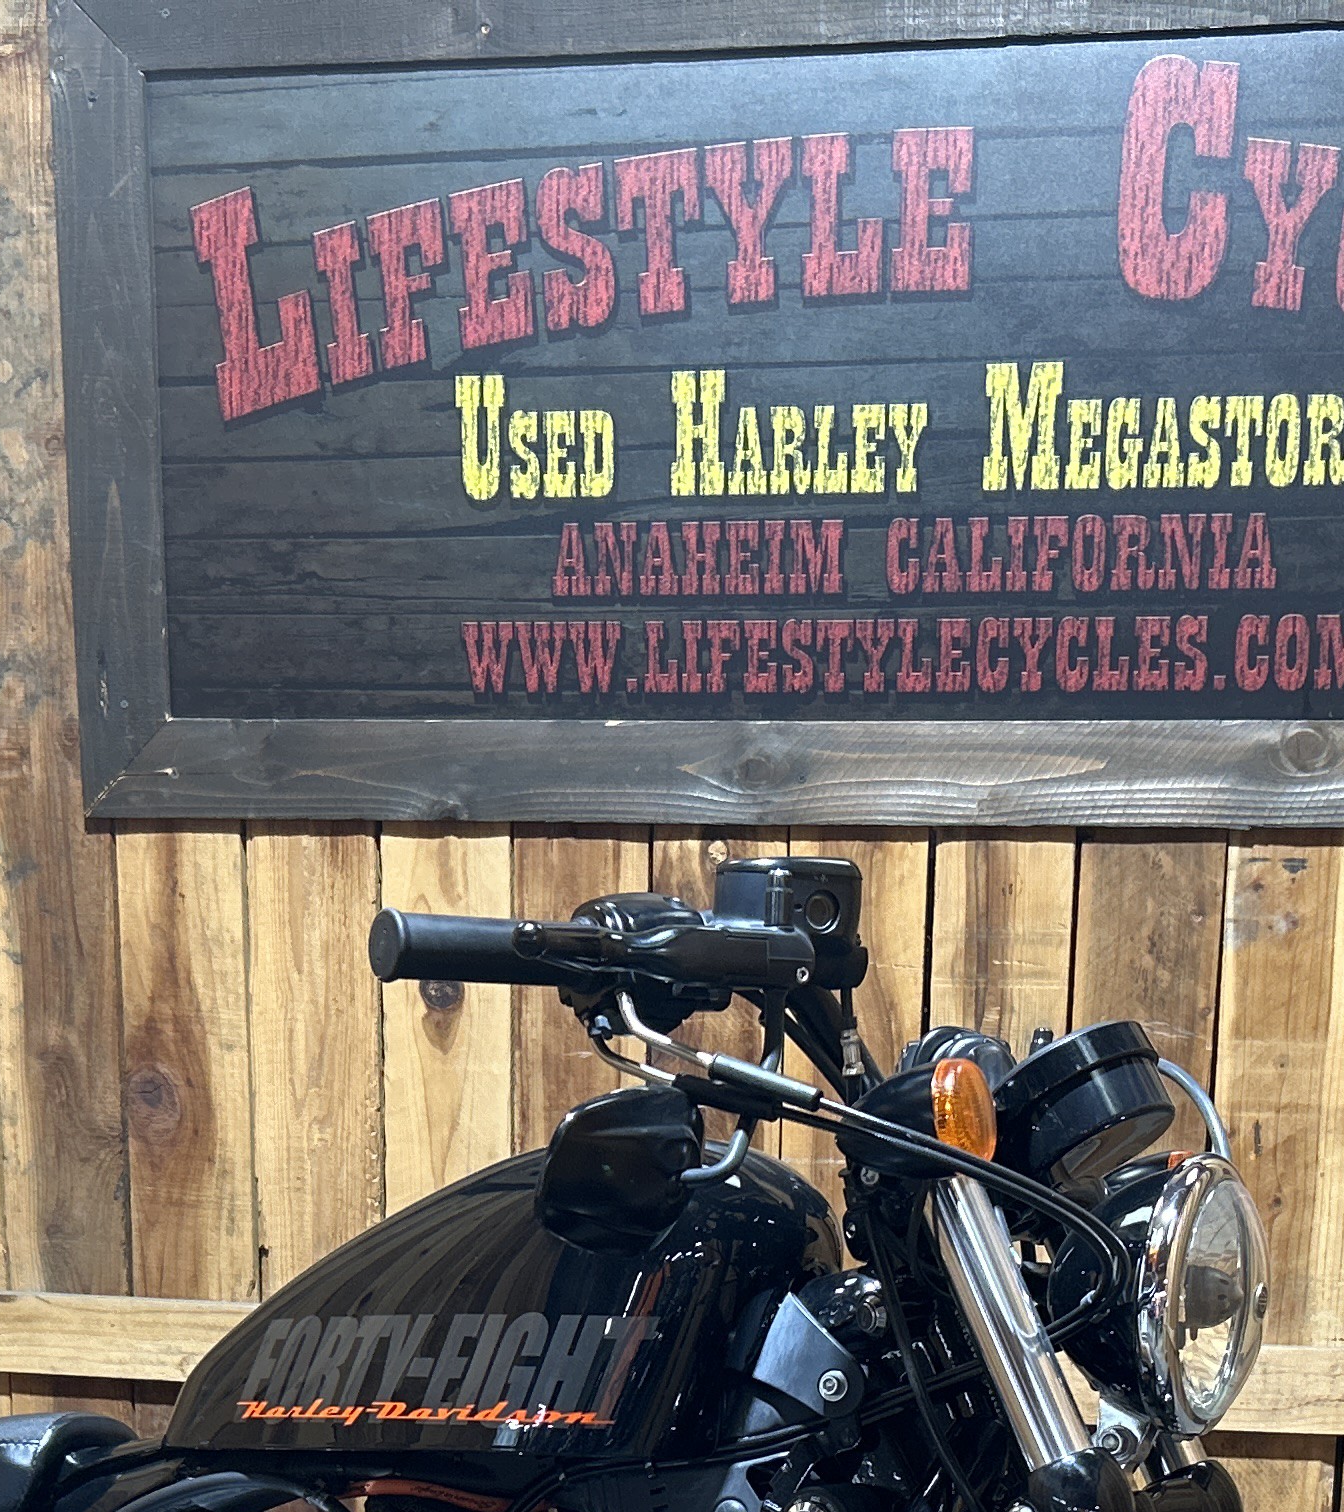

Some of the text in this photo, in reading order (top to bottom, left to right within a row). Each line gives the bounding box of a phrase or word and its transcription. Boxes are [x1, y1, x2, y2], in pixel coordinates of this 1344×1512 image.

[191, 124, 974, 422] LIFESTYLE
[455, 375, 614, 502] USED
[671, 370, 928, 497] HARLEY
[552, 512, 1276, 597] ANAHEIM CALIFORNIA
[236, 1311, 660, 1427] FORTY-EIGHT
[236, 1398, 616, 1427] Harley-Davidson
